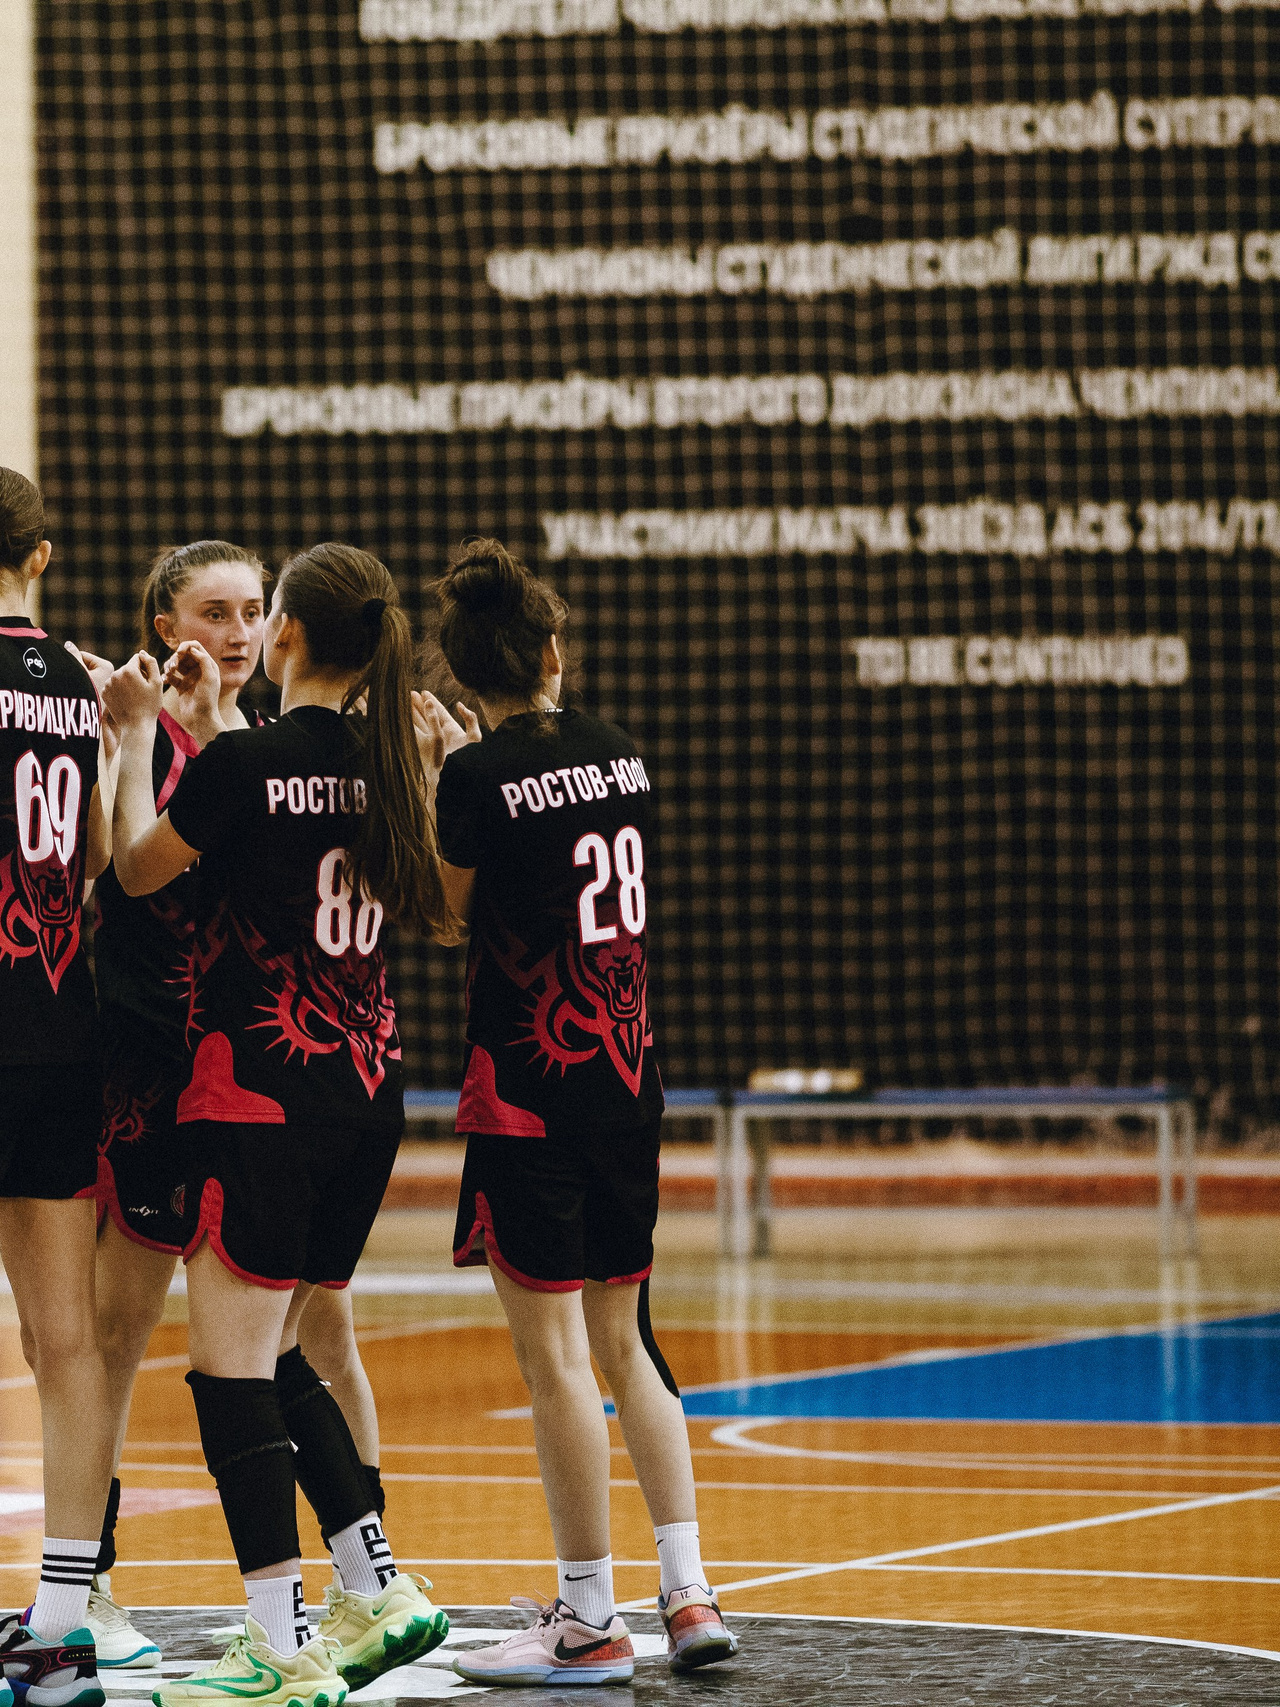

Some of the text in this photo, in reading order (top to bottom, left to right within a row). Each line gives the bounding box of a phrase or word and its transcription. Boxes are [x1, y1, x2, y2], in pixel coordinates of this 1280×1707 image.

[1078, 366, 1280, 420] ЧЕМПИОН
[964, 634, 1189, 687] CONTINUED
[13, 748, 82, 867] 69
[572, 824, 648, 947] 28
[680, 1590, 691, 1600] 12
